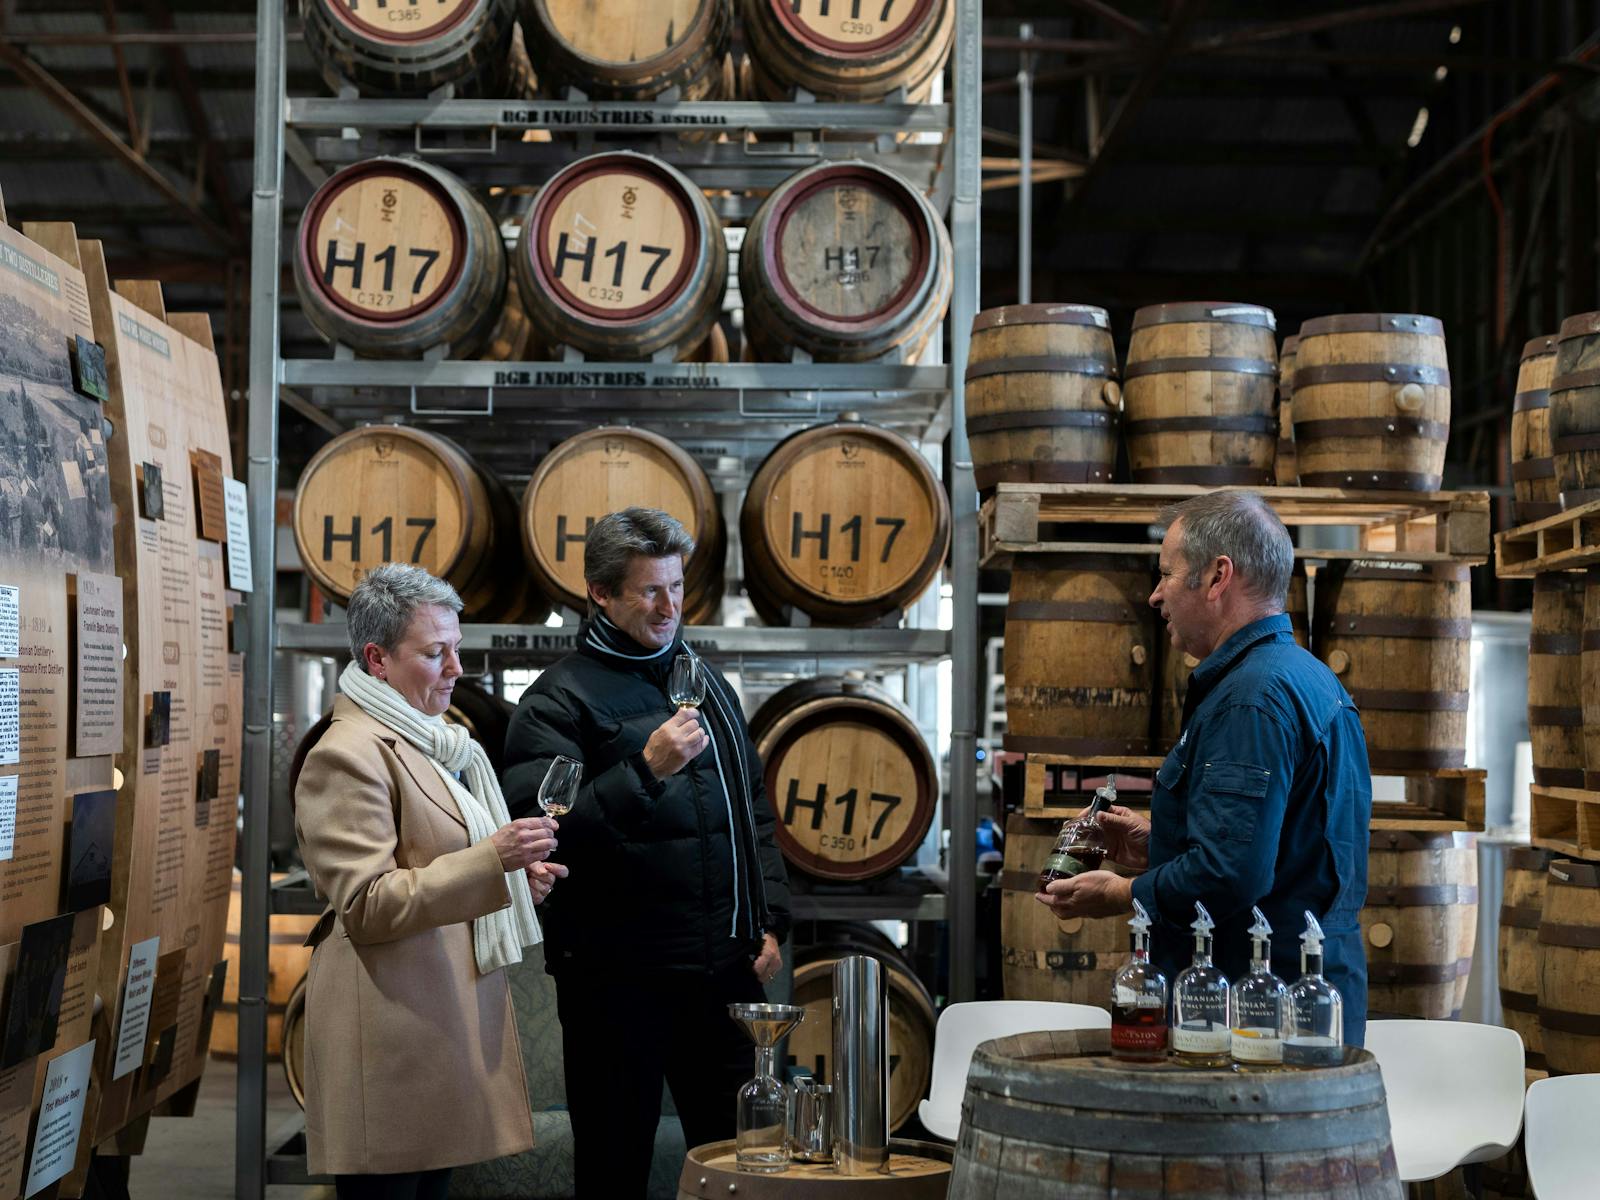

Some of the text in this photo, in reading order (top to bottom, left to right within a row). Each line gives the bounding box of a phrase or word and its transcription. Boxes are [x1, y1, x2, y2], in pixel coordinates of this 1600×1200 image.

[543, 110, 654, 124] INDUSTRIES
[660, 114, 727, 124] AUSTRALIA
[323, 239, 440, 294] H17
[554, 231, 671, 291] H17
[824, 246, 881, 270] H17
[535, 371, 646, 386] INDUSTRIES
[322, 515, 437, 564] H17
[791, 511, 906, 563] H17
[784, 778, 902, 840] H17
[820, 834, 855, 851] C350
[1182, 994, 1221, 1002] SMANIAN
[1240, 1001, 1266, 1009] ANIAN
